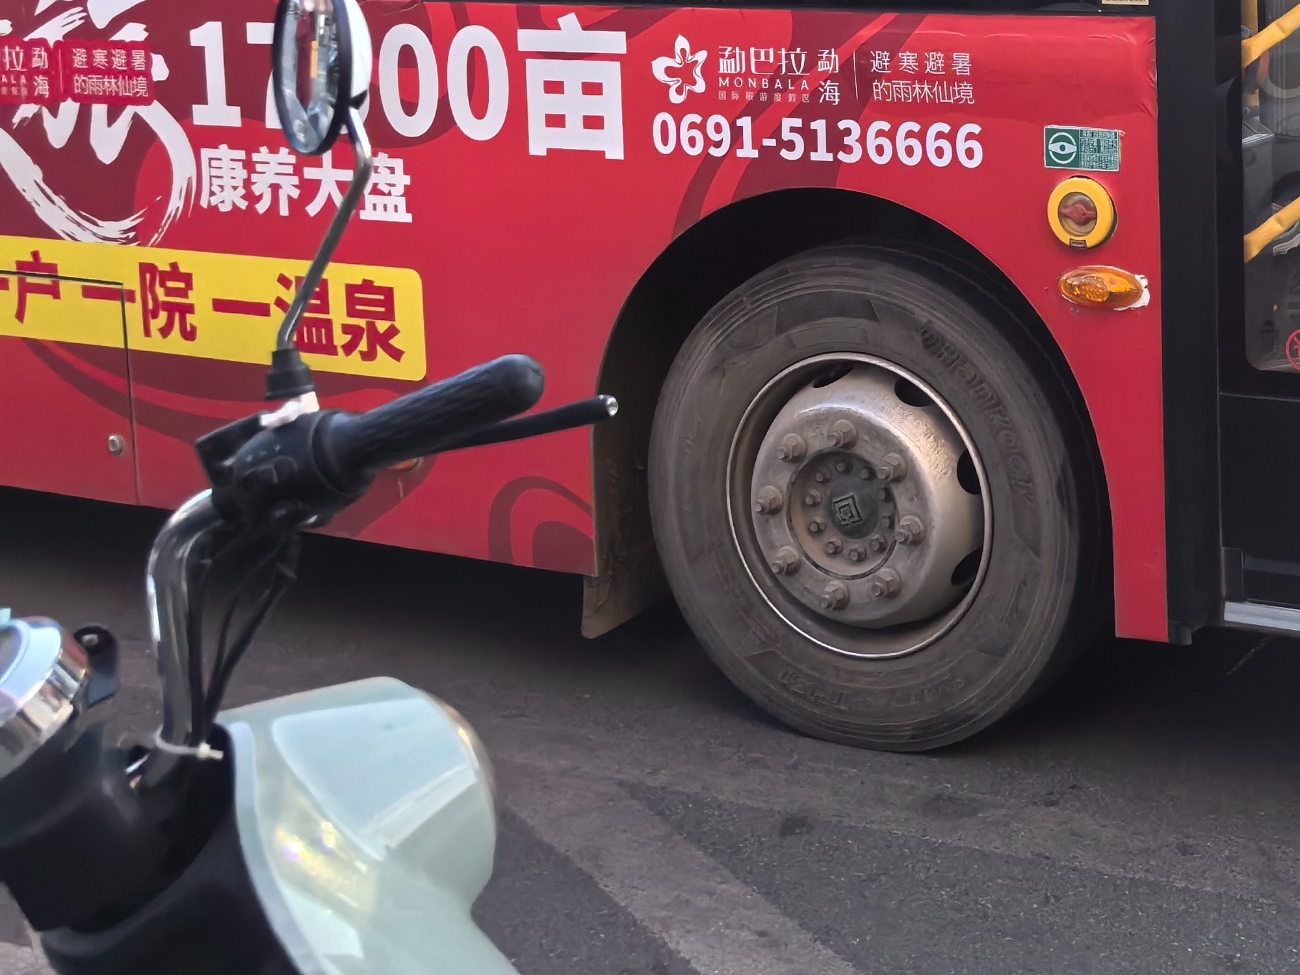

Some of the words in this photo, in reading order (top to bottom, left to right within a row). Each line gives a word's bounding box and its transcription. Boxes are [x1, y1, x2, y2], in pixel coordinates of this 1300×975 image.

[72, 48, 146, 71] 避寒避暑
[718, 45, 810, 76] 勐巴拉
[870, 50, 973, 76] 避寒避暑
[73, 74, 149, 98] 的雨林仙境
[189, 12, 627, 161] 100亩
[718, 76, 809, 91] MONBALA
[872, 79, 976, 105] 的雨林仙境
[652, 111, 984, 169] 0691-5136666
[200, 143, 413, 223] 康养大盘
[0, 250, 406, 364] 户一院一温泉
